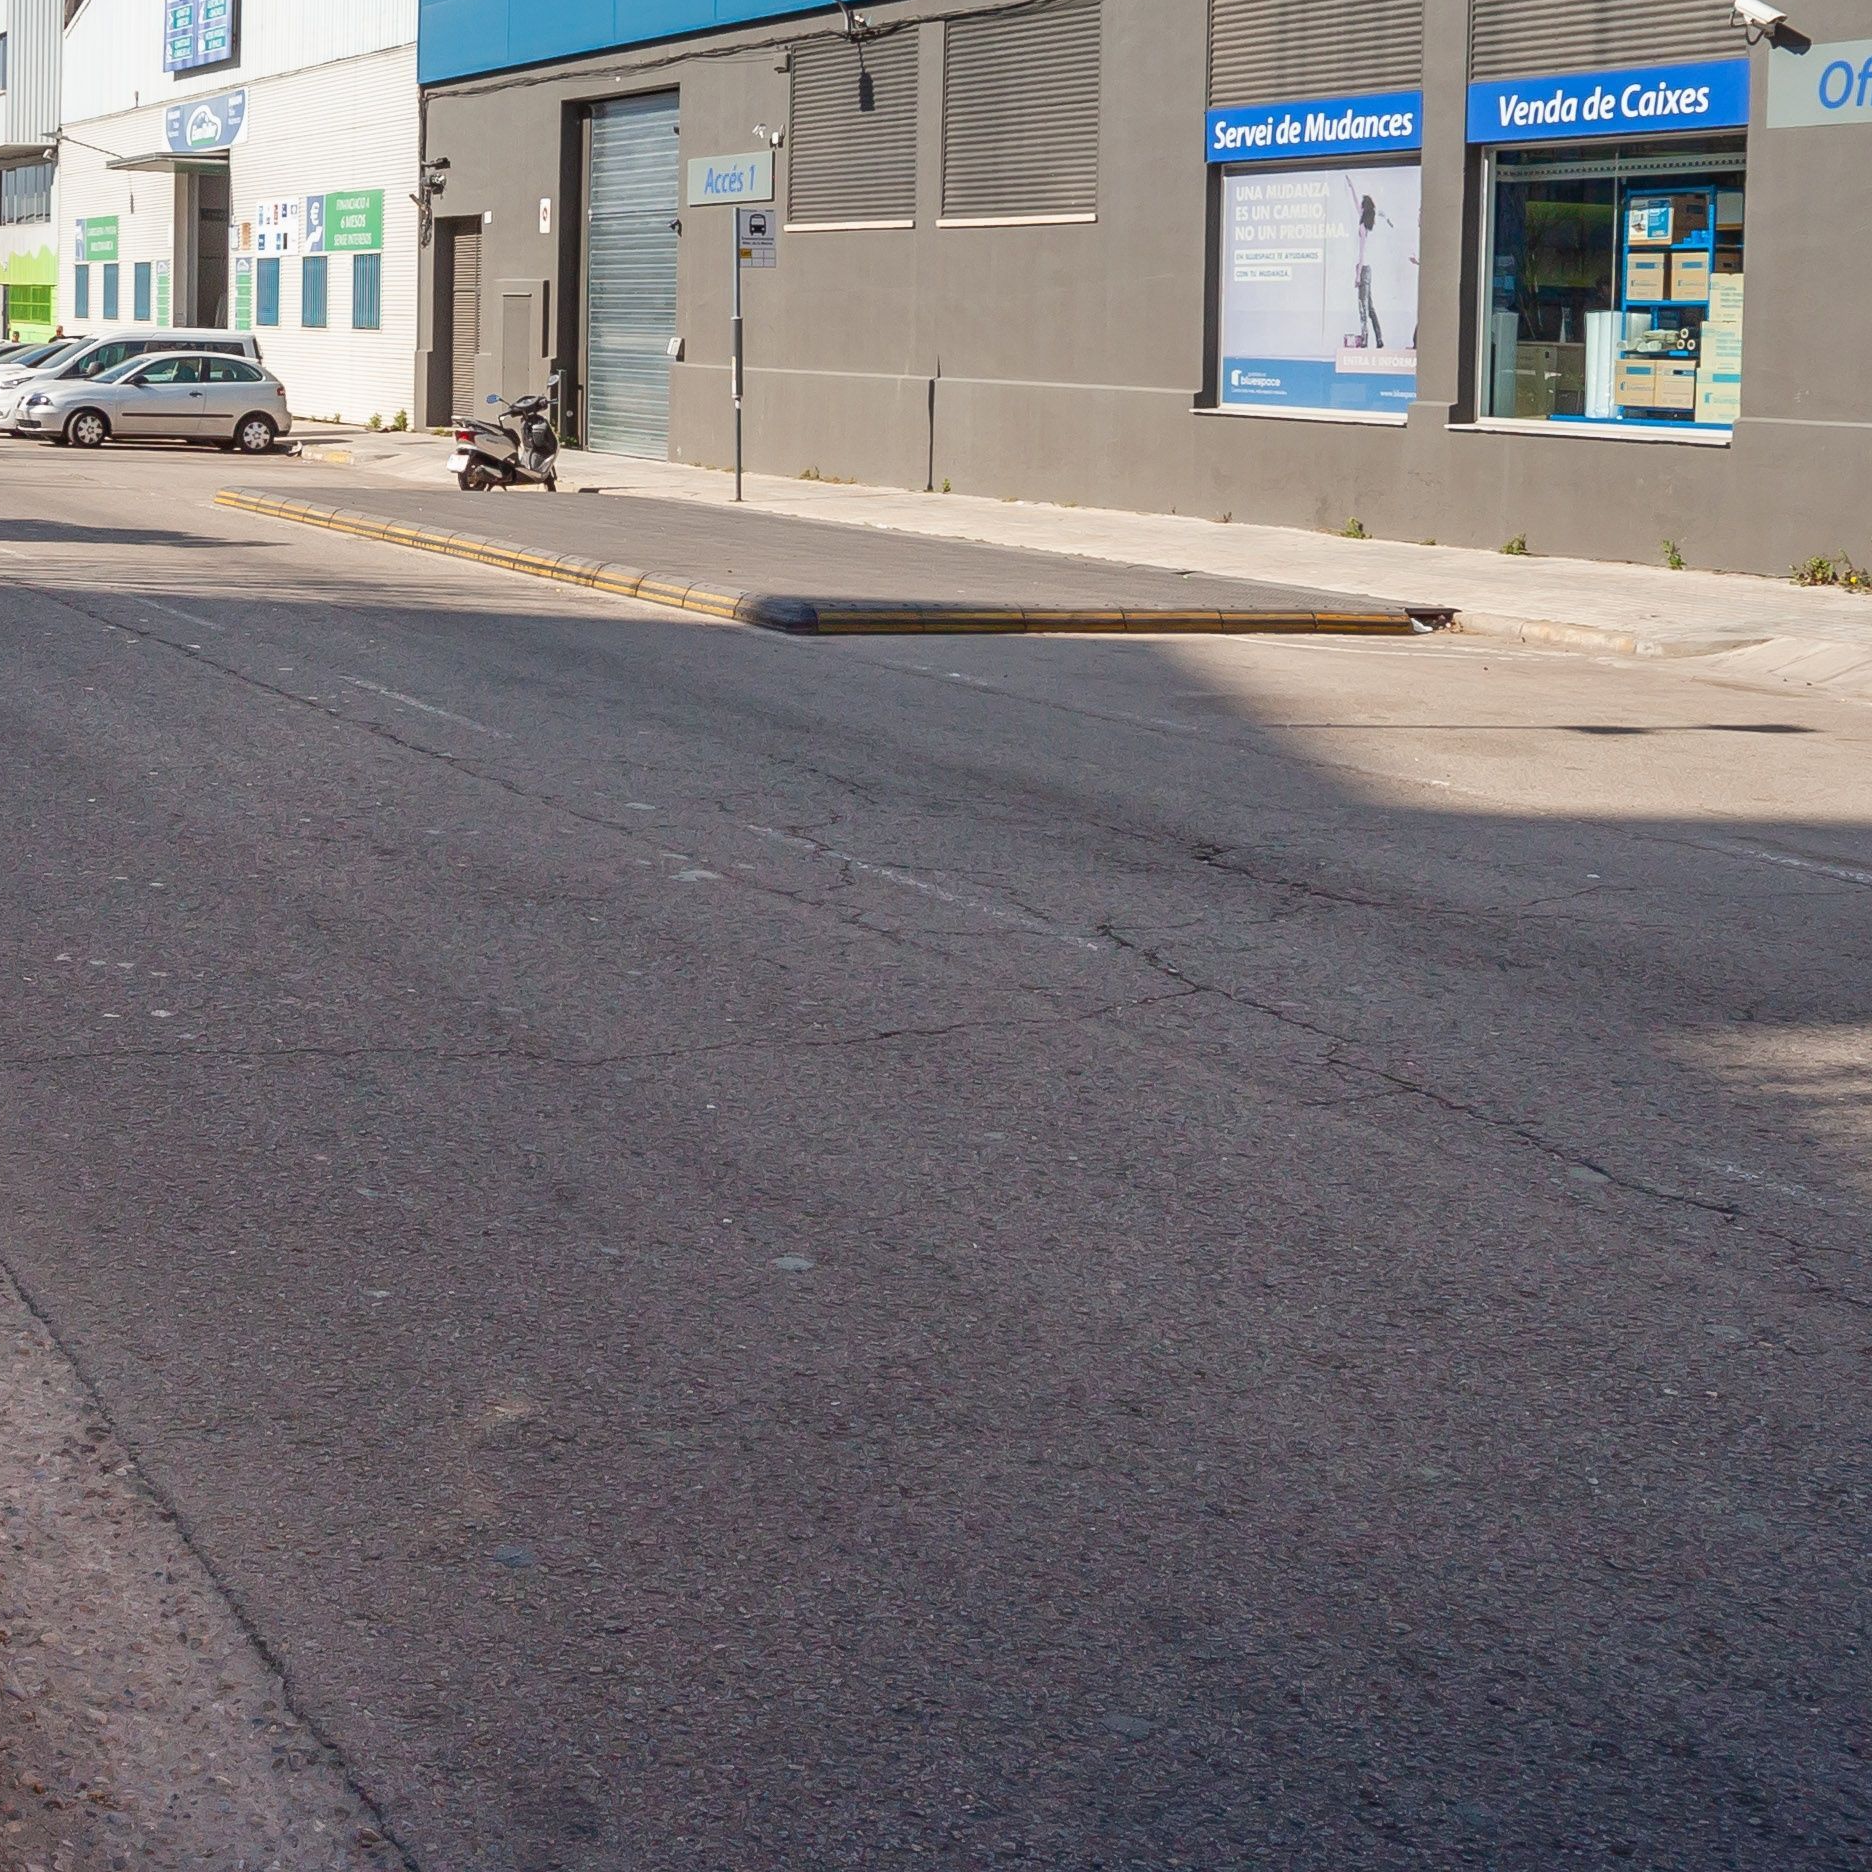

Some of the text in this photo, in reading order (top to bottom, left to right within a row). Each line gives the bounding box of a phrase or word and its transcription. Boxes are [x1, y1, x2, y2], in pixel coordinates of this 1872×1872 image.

[1499, 82, 1709, 126] Venda de Caixes
[1214, 109, 1413, 149] Servei de Mudances
[704, 164, 756, 195] Accés 1
[1236, 181, 1330, 201] UNA MUDANZA
[346, 214, 366, 228] MESOS
[1235, 206, 1248, 221] ES
[1251, 204, 1270, 220] UN
[1235, 222, 1350, 241] NO UN PROBLEMA.
[1343, 355, 1370, 366] ENTRA
[1372, 356, 1377, 366] E
[1240, 376, 1281, 388] bluespace
